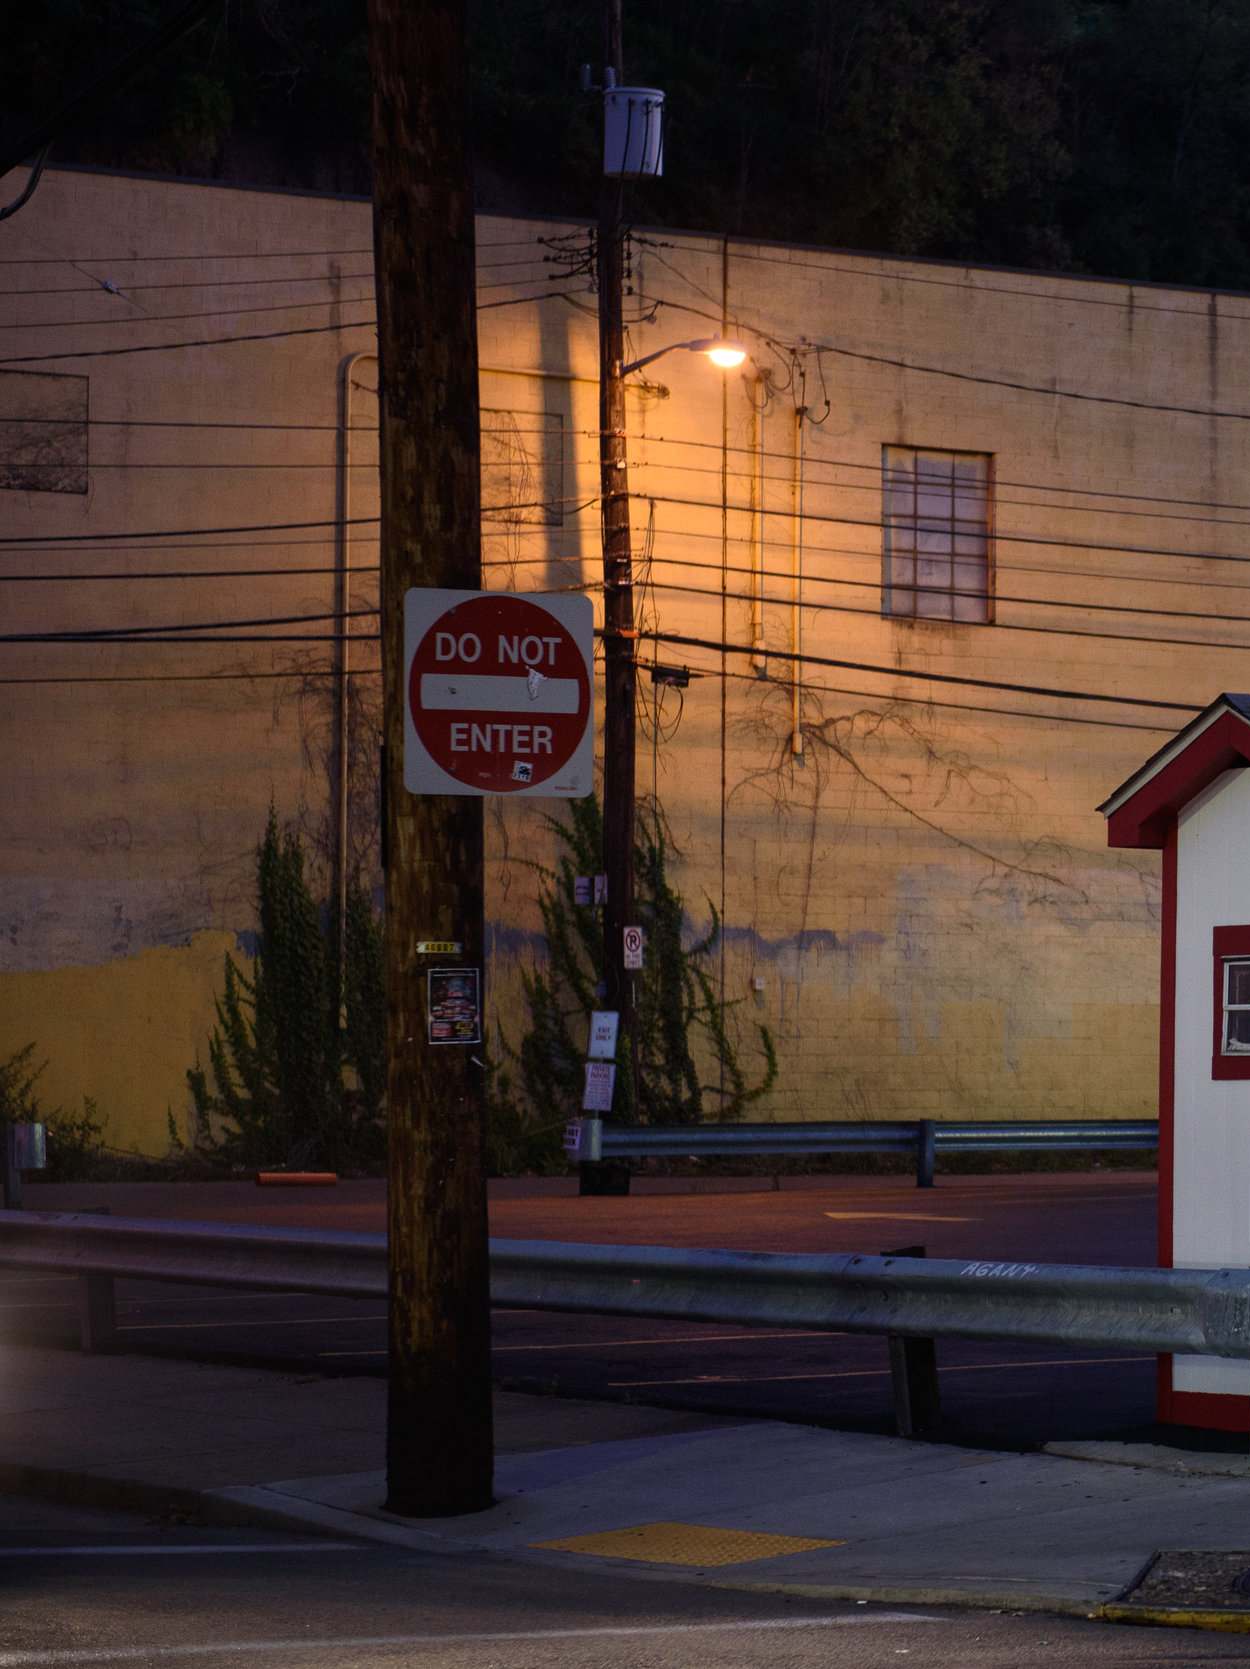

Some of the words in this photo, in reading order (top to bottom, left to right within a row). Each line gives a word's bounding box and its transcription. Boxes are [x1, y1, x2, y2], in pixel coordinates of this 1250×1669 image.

[435, 632, 482, 663] DO
[498, 635, 562, 665] NOT
[450, 722, 553, 754] ENTER
